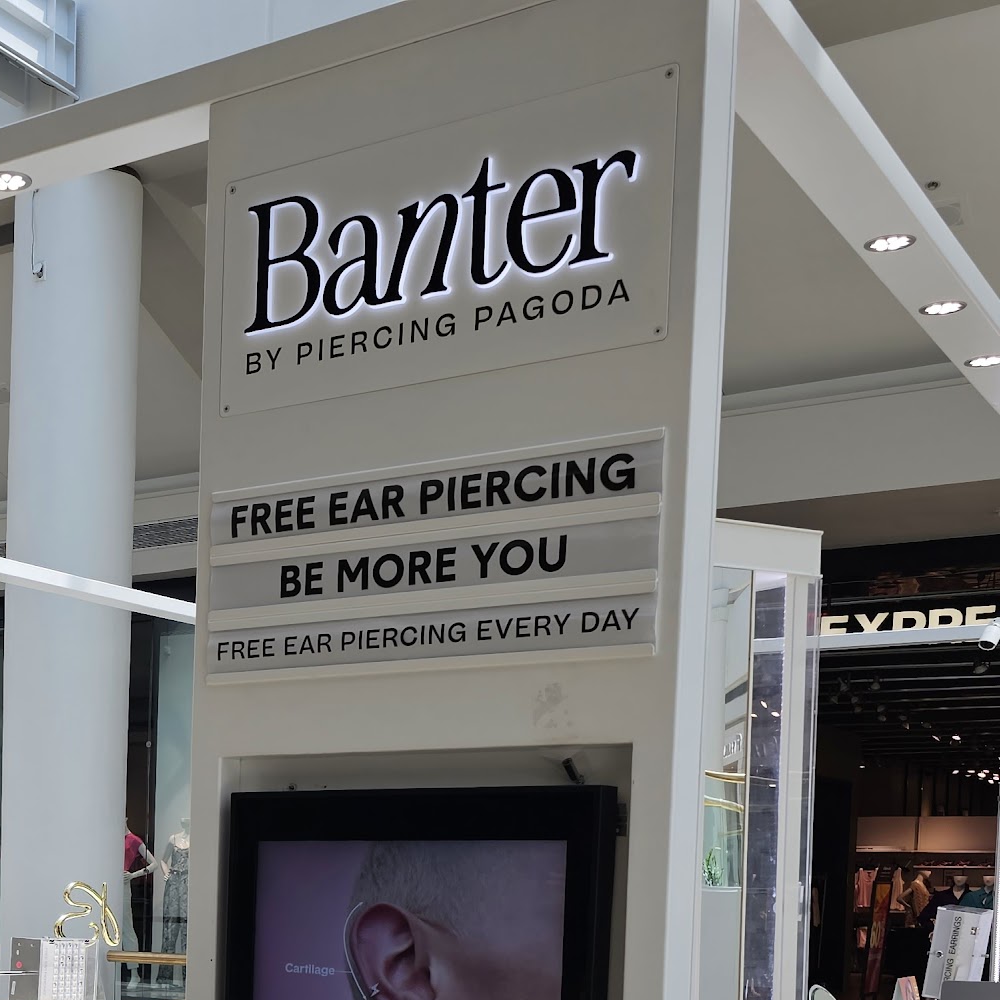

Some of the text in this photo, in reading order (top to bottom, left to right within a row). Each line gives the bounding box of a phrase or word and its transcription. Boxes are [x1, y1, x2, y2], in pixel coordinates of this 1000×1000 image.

[243, 148, 639, 336] Banter
[246, 278, 631, 376] BY PIERCING PAGODA
[230, 453, 637, 539] FREE EAR PIERCING
[280, 534, 568, 599] BE MORE YOU
[217, 607, 640, 661] FREE EAR PIERCING EVERY DAY
[285, 962, 336, 977] Cartilage
[943, 916, 963, 981] RCING EARRINGS
